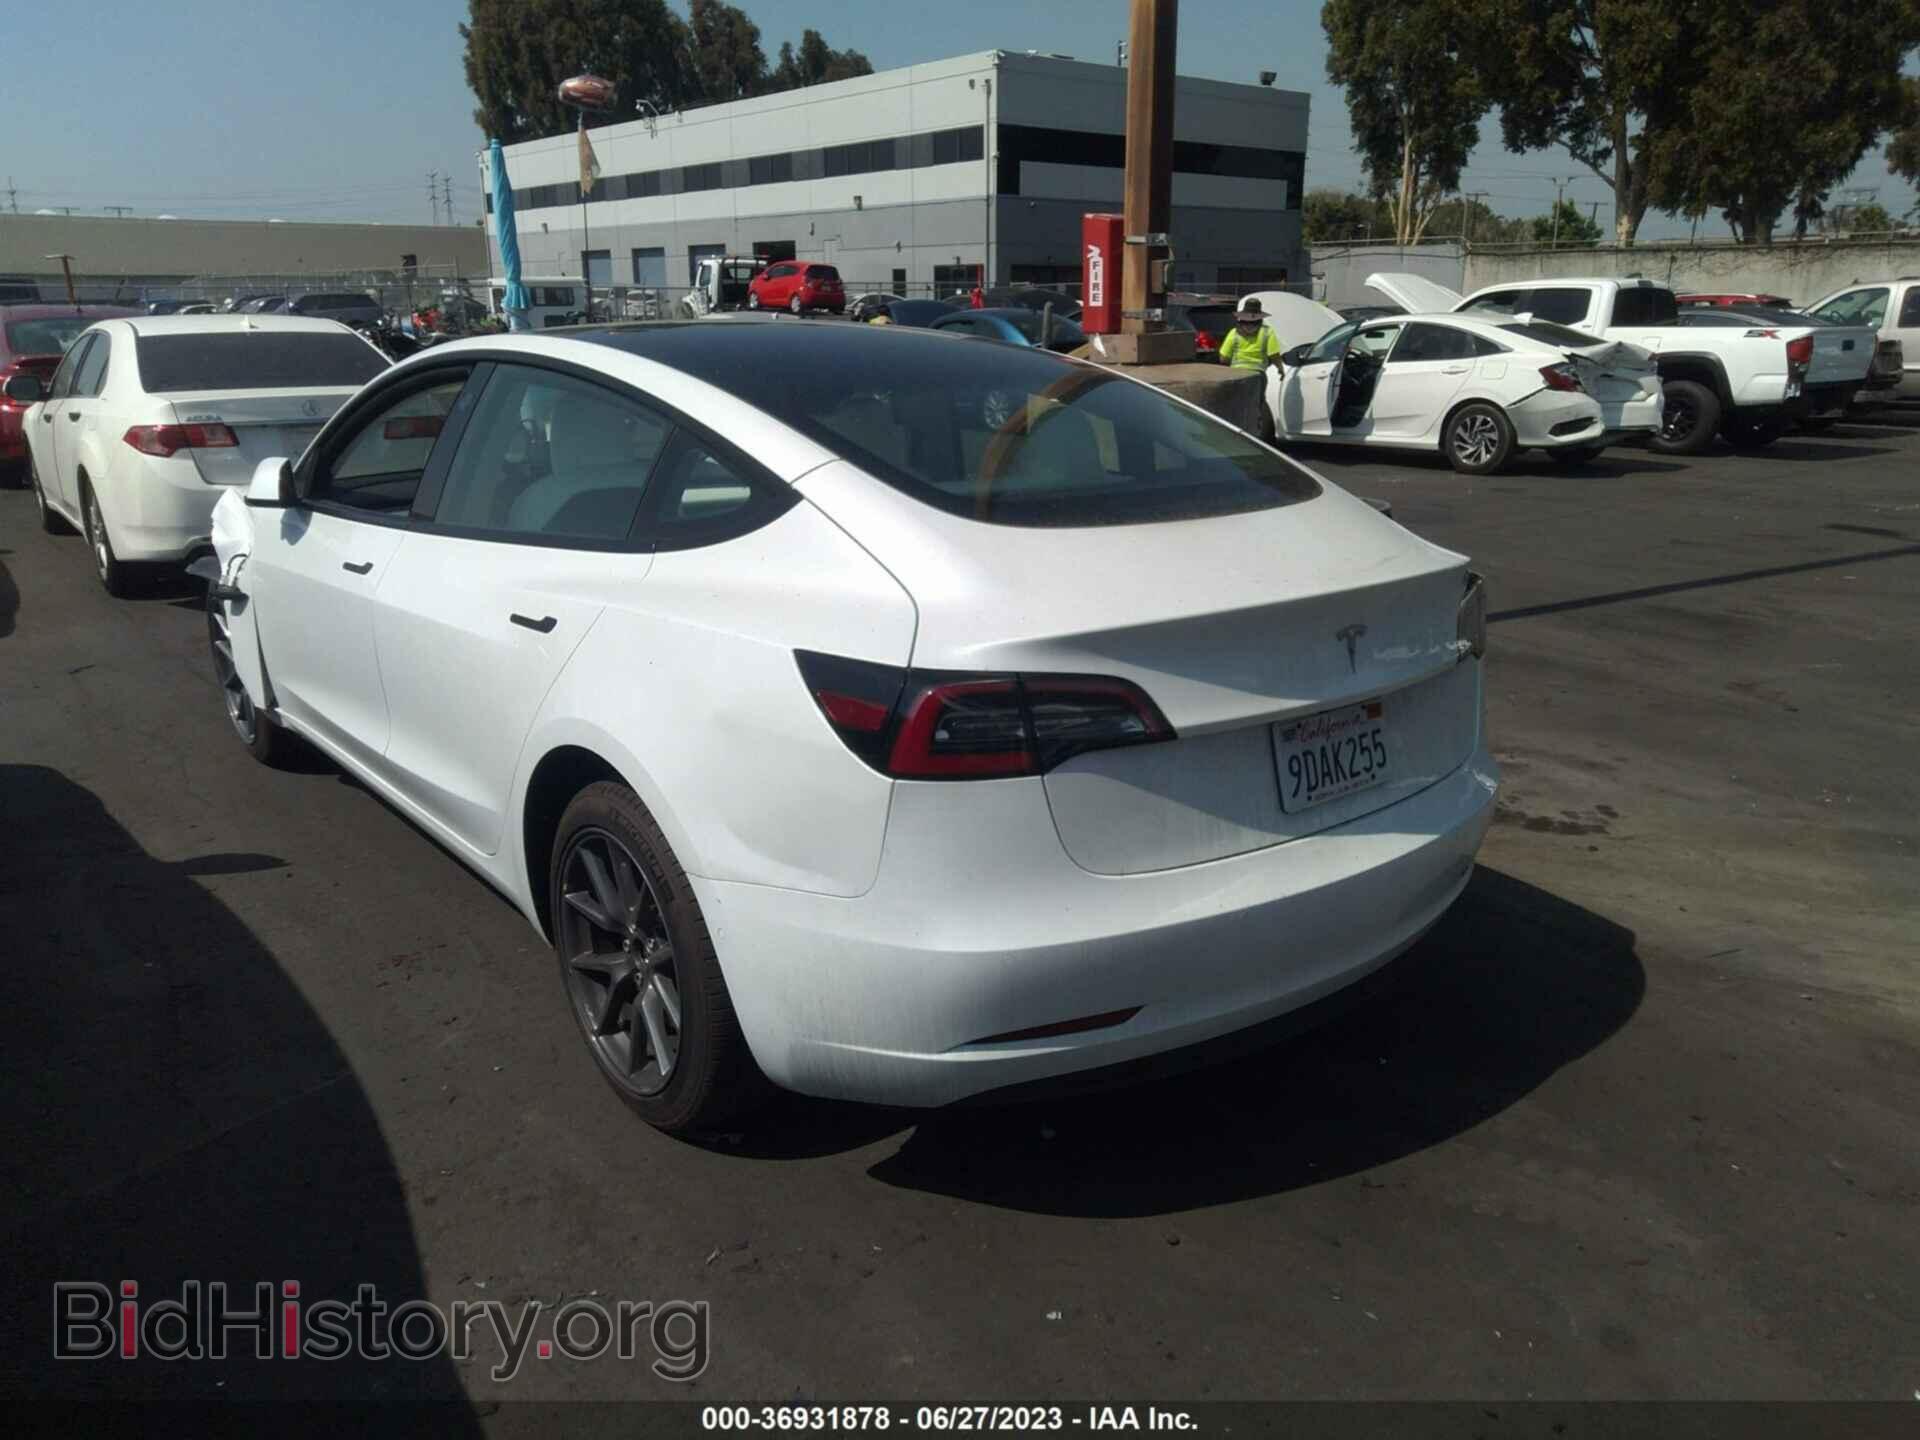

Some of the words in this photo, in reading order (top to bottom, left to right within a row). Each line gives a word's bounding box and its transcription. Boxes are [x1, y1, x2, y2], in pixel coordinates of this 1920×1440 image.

[1091, 260, 1101, 303] FIRE
[1297, 712, 1361, 743] California
[1287, 728, 1387, 799] 9DAK255
